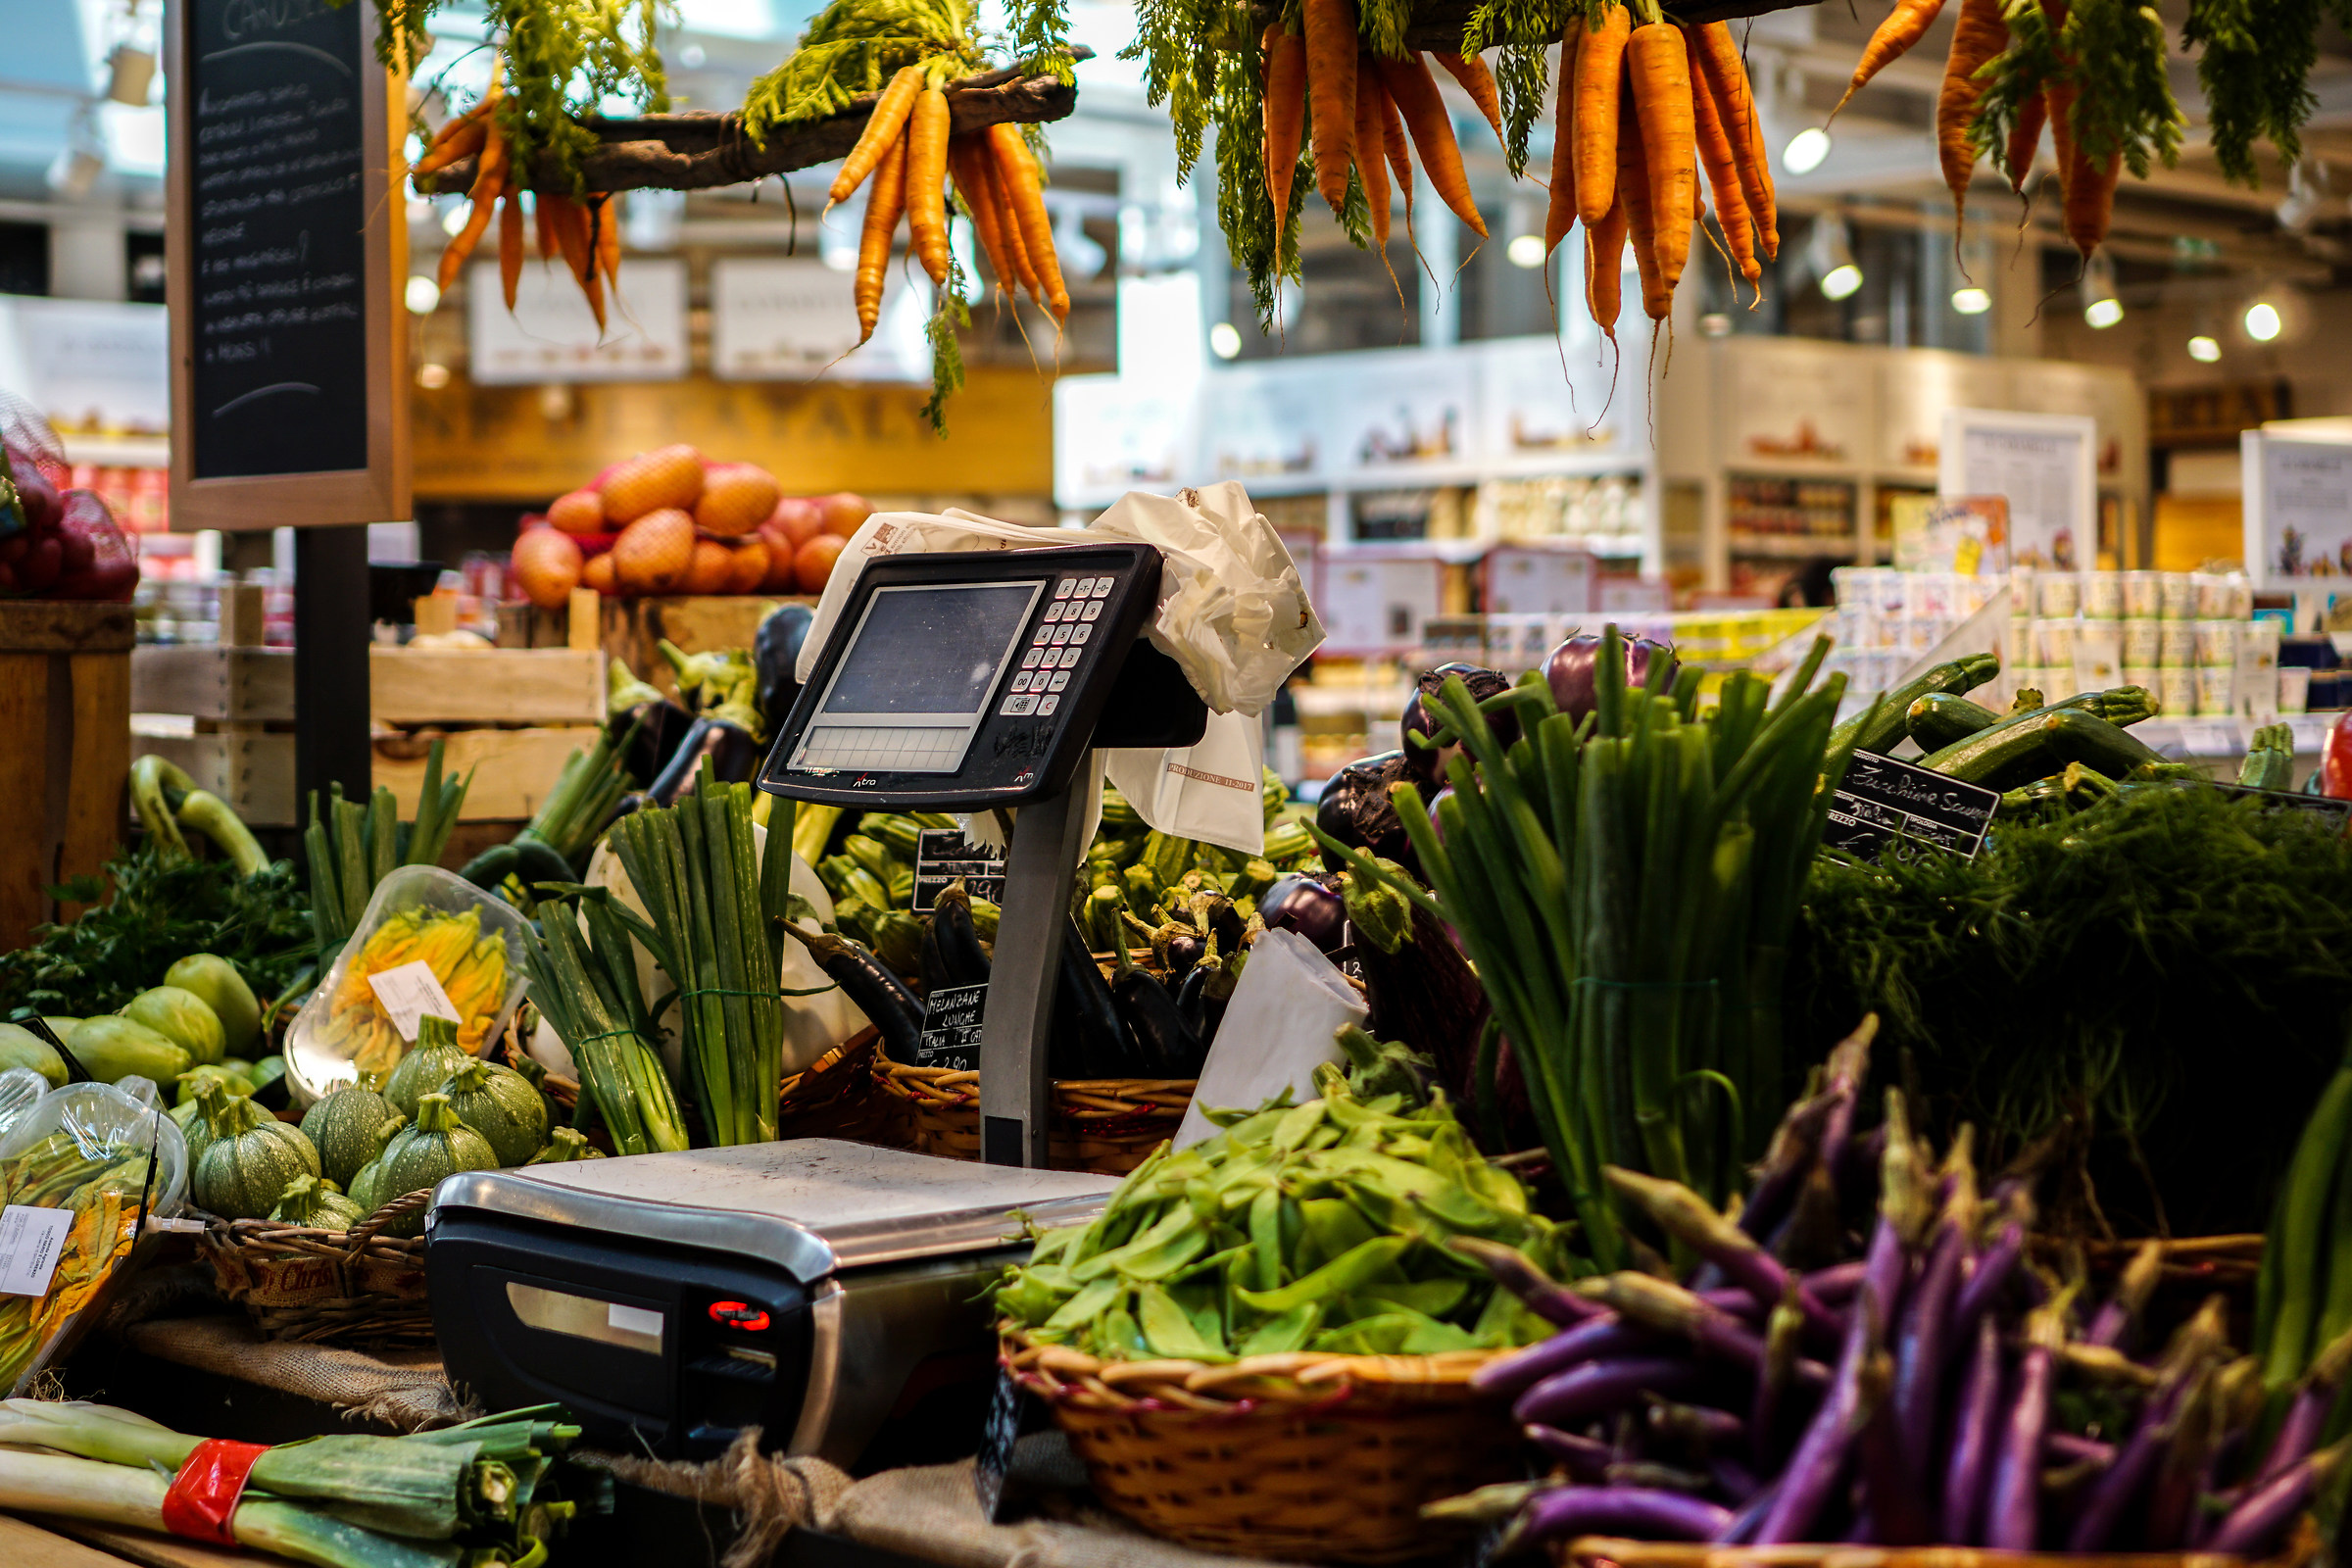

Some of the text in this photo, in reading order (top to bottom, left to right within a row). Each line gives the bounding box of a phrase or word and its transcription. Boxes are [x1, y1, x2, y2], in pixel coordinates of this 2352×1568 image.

[1853, 751, 1880, 763] RODOTTO
[1168, 763, 1221, 784] PRODUZIONE
[1828, 811, 1857, 828] REZZO
[928, 990, 980, 1015] MELANZANE
[942, 1009, 976, 1027] LUNGHE
